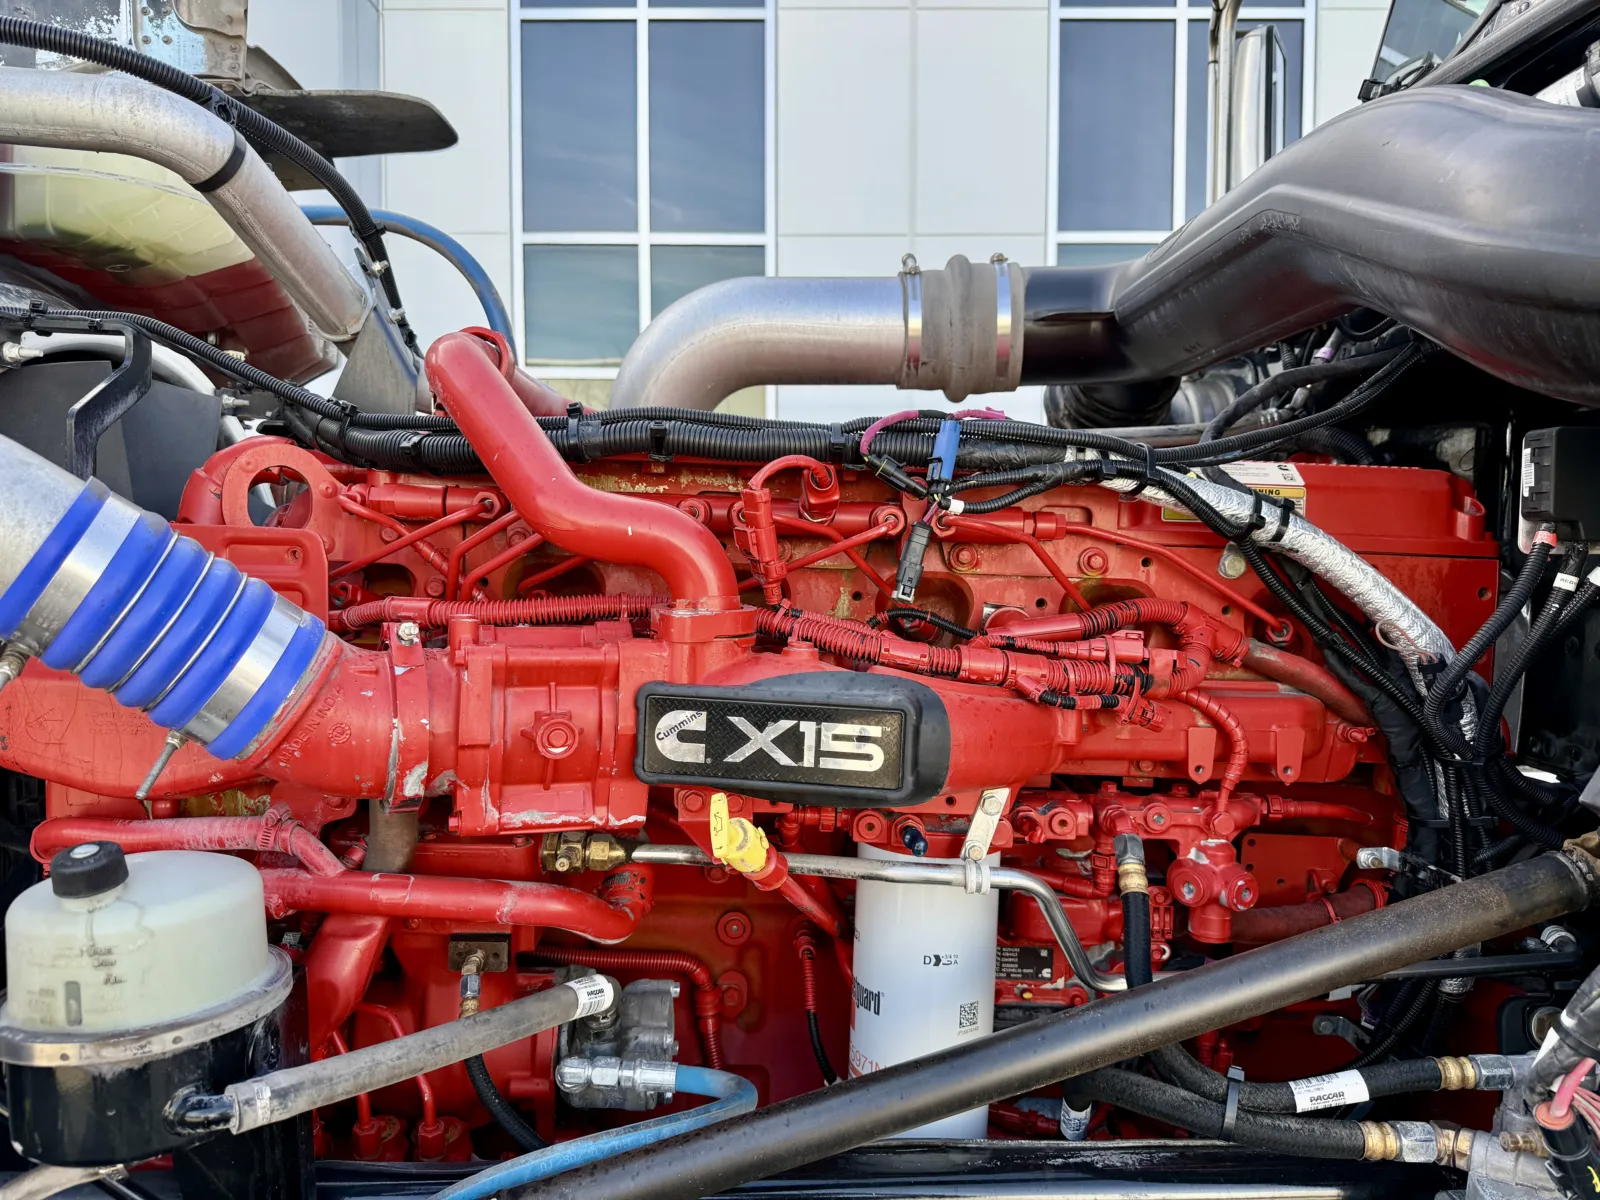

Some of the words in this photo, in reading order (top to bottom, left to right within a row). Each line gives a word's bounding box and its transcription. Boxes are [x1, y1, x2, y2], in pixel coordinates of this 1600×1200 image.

[305, 719, 320, 733] IN
[656, 710, 703, 741] Cummins
[723, 716, 885, 772] X15
[1310, 1091, 1345, 1103] PACCAR
